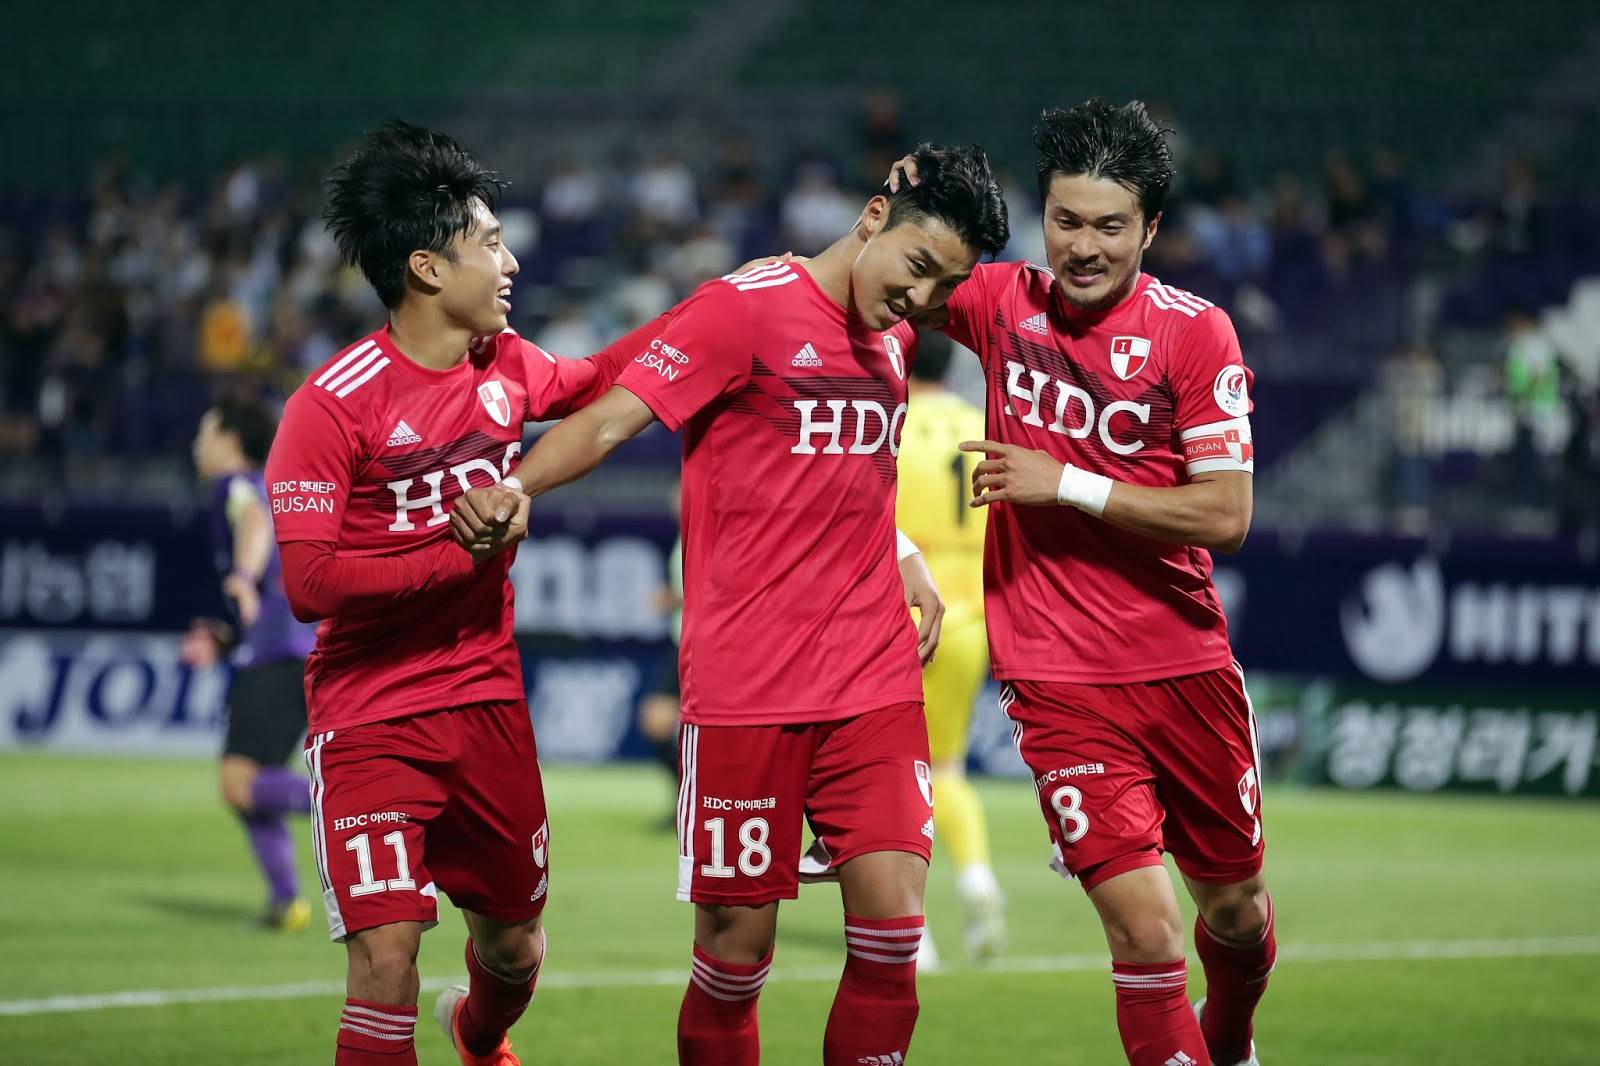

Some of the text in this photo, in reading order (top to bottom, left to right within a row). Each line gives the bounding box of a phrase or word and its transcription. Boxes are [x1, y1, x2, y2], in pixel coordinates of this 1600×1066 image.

[792, 358, 822, 367] adidas
[1005, 361, 1150, 455] HDC
[386, 434, 422, 447] adidas
[1186, 442, 1221, 456] BUSAN
[272, 480, 297, 494] HDC
[273, 496, 334, 514] BUSAN
[703, 796, 733, 811] HDC
[334, 814, 368, 831] HDC
[1051, 785, 1089, 843] 8
[701, 817, 772, 878] 18
[346, 830, 416, 897] 11
